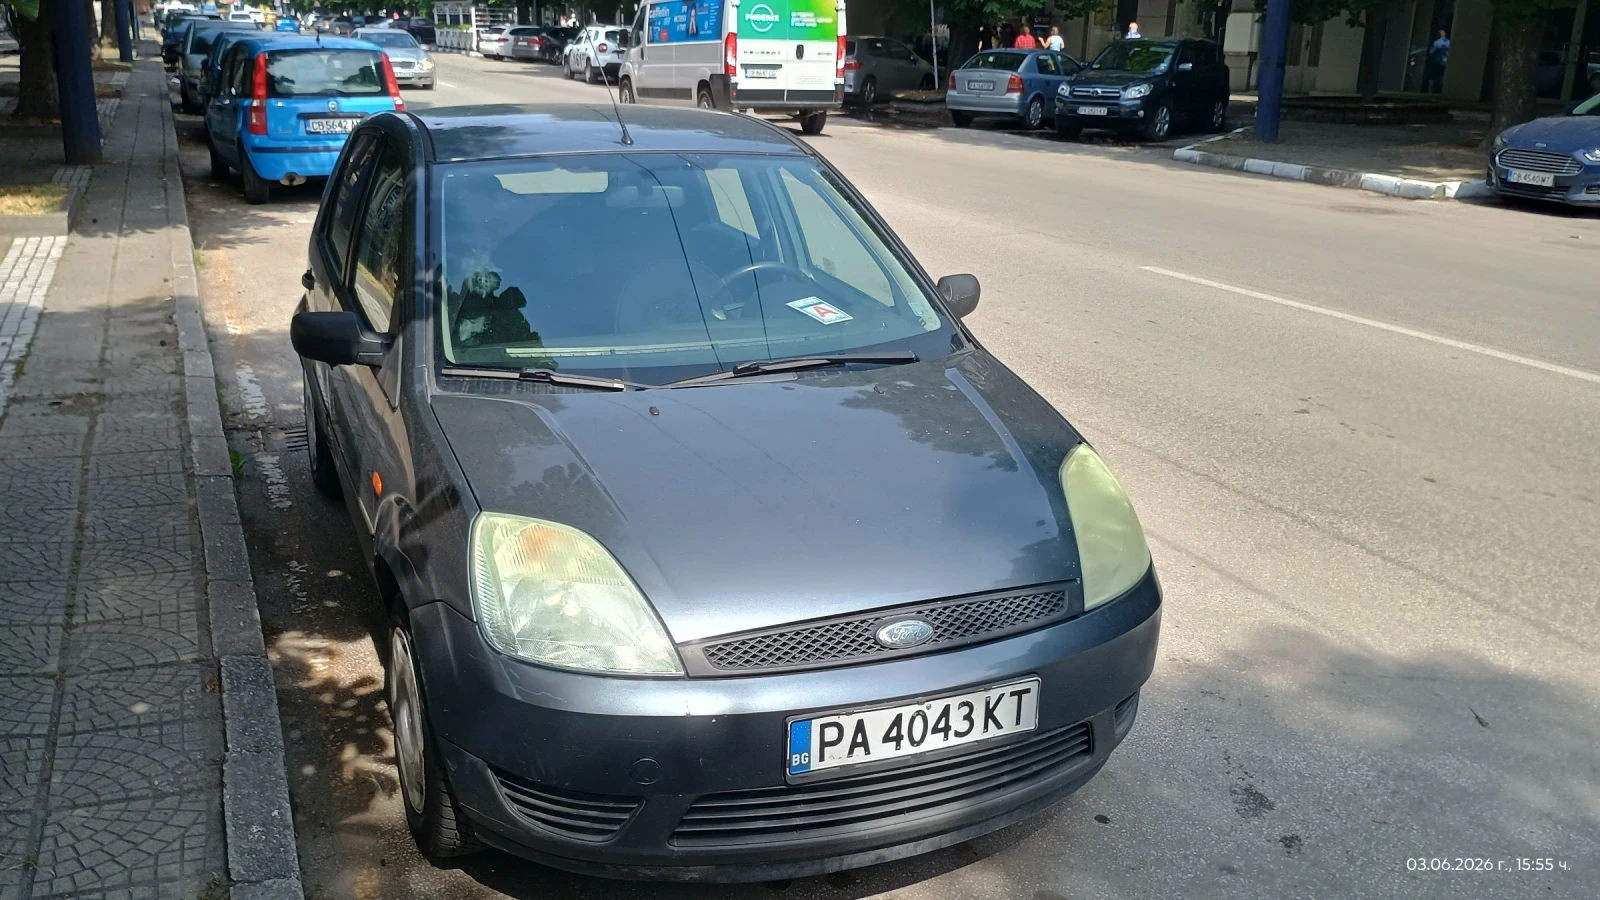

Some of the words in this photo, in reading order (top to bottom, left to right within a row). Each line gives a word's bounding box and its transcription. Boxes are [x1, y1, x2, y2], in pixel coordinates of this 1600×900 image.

[745, 13, 780, 22] PHOENIX
[325, 120, 349, 130] 5642
[1523, 173, 1540, 183] 4540
[813, 305, 839, 318] A
[891, 624, 922, 641] Ford
[818, 718, 871, 763] PA
[881, 700, 975, 751] 4043
[982, 687, 1032, 734] KT
[792, 752, 809, 767] BG
